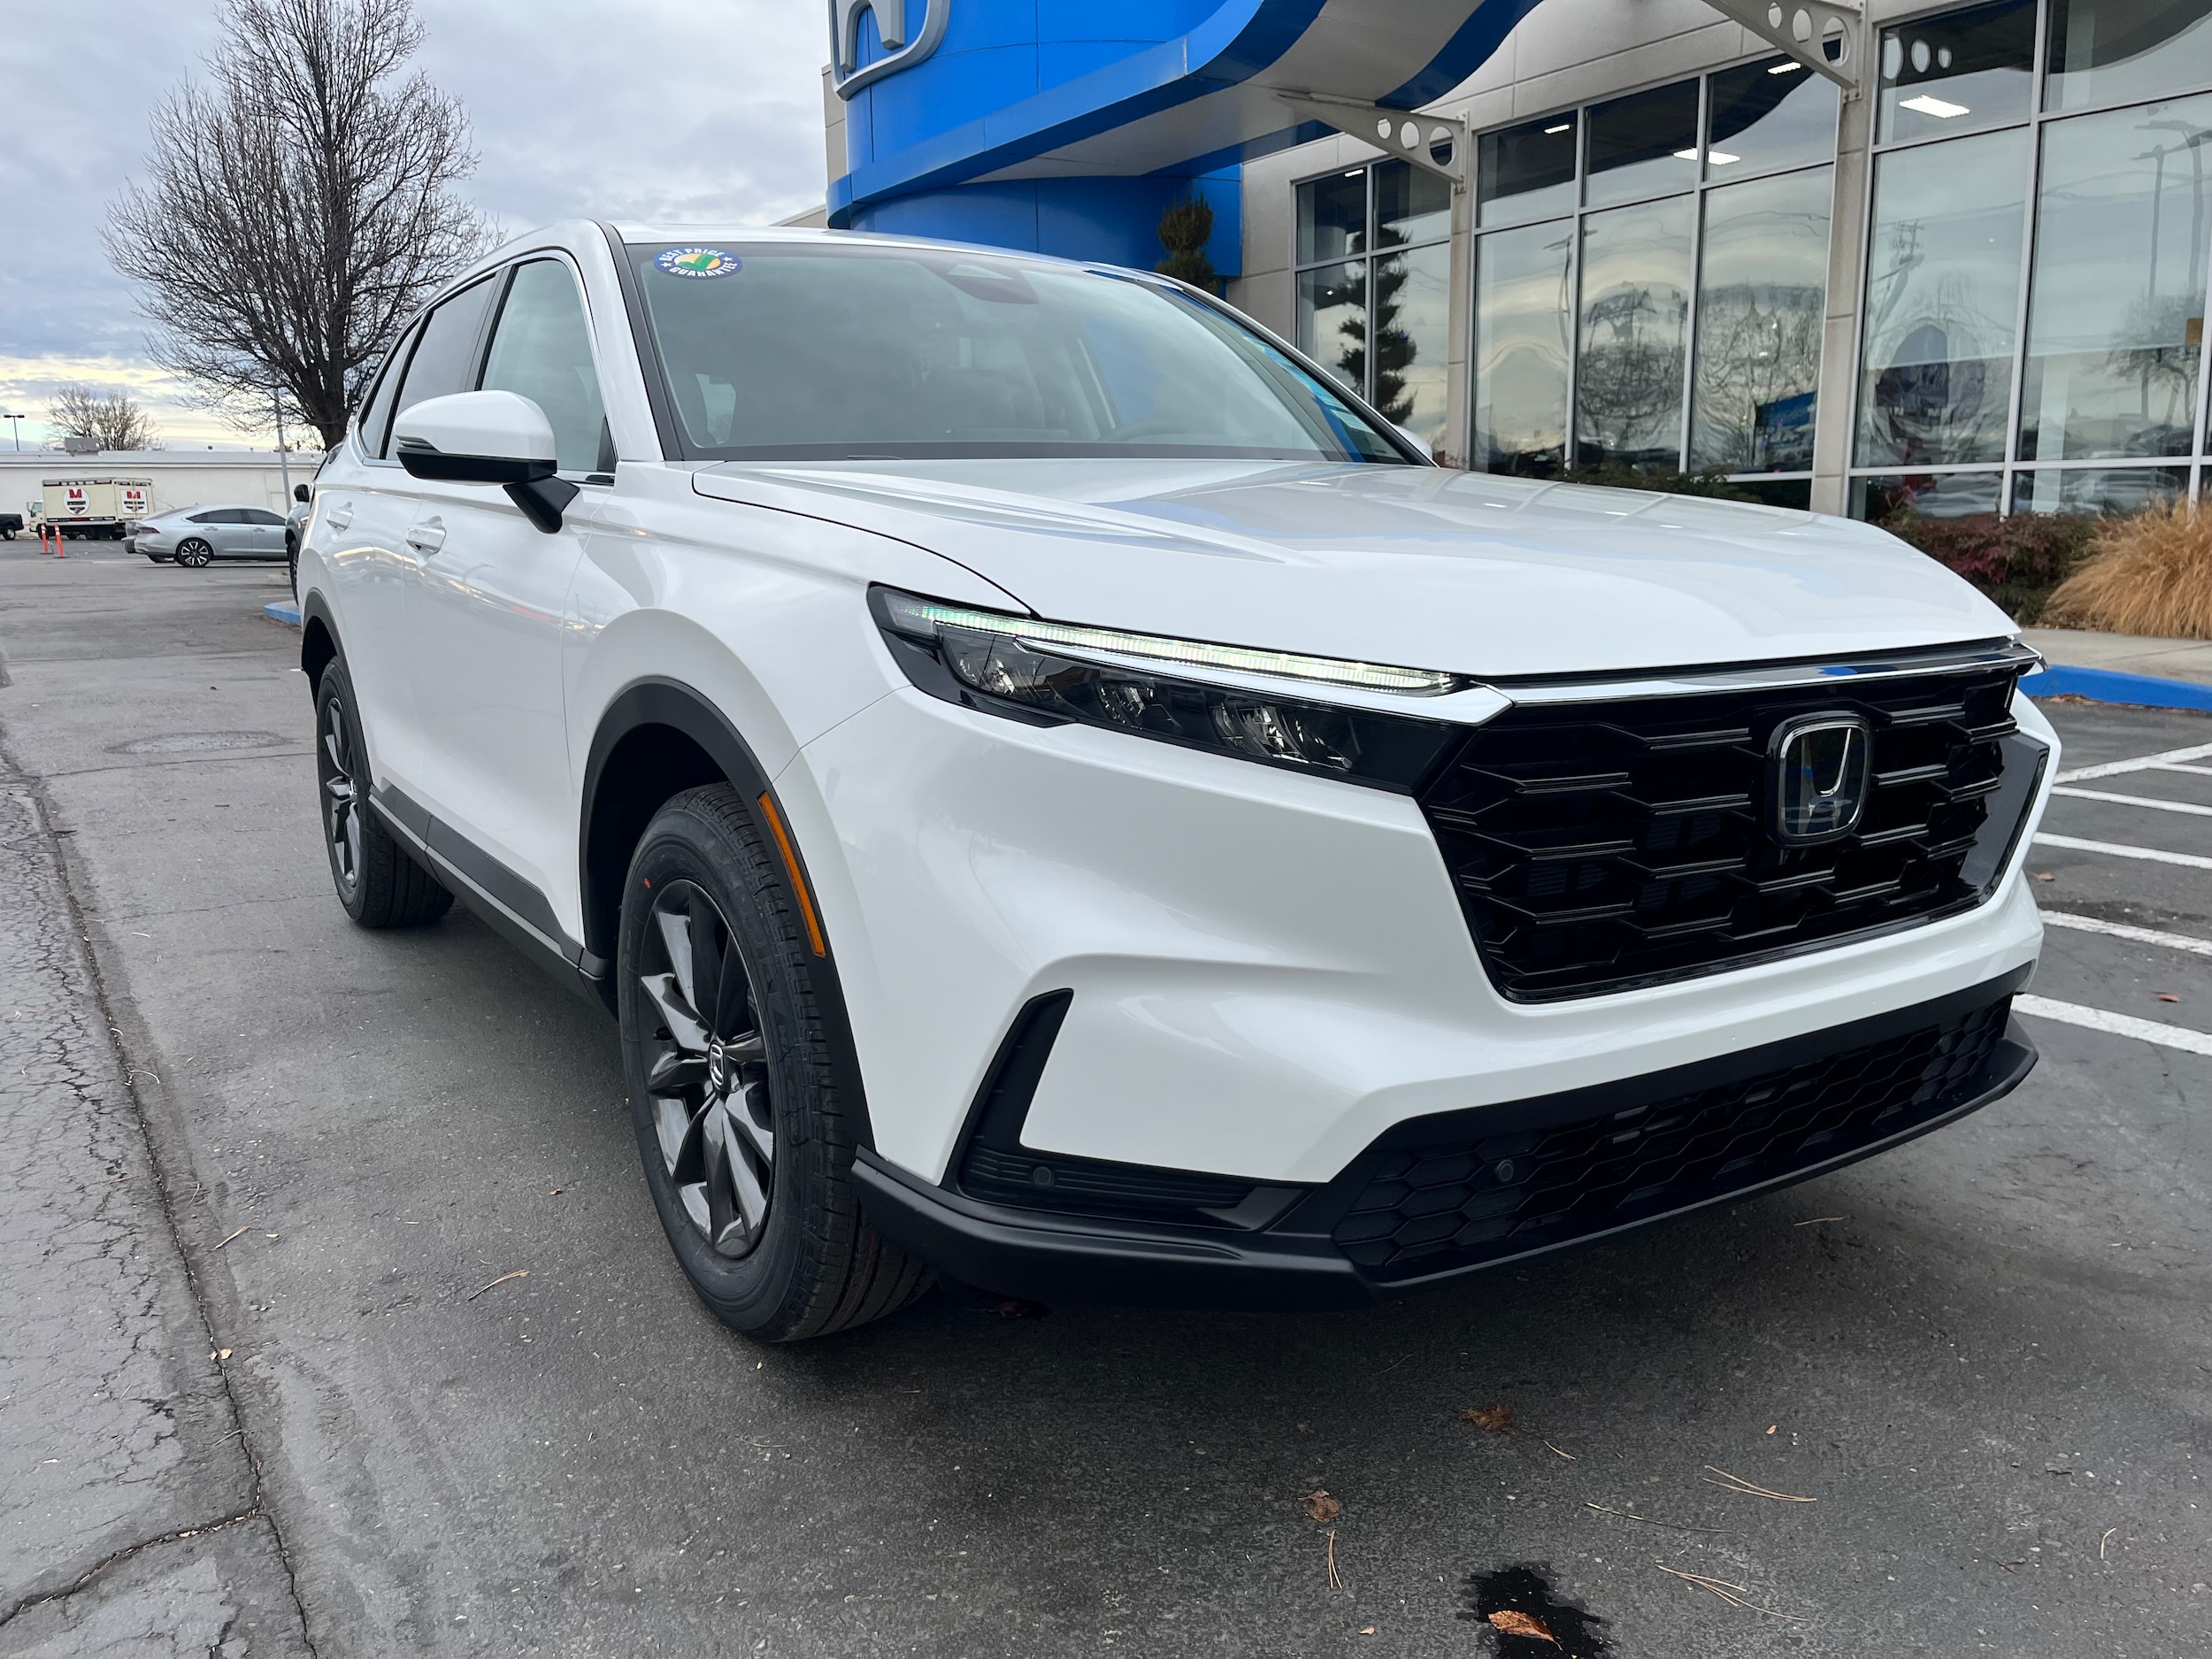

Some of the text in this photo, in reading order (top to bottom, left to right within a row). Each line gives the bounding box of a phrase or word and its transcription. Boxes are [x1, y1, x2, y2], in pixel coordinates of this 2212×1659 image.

[658, 248, 726, 261] BEST PRICE
[669, 262, 738, 277] GUARANTEE
